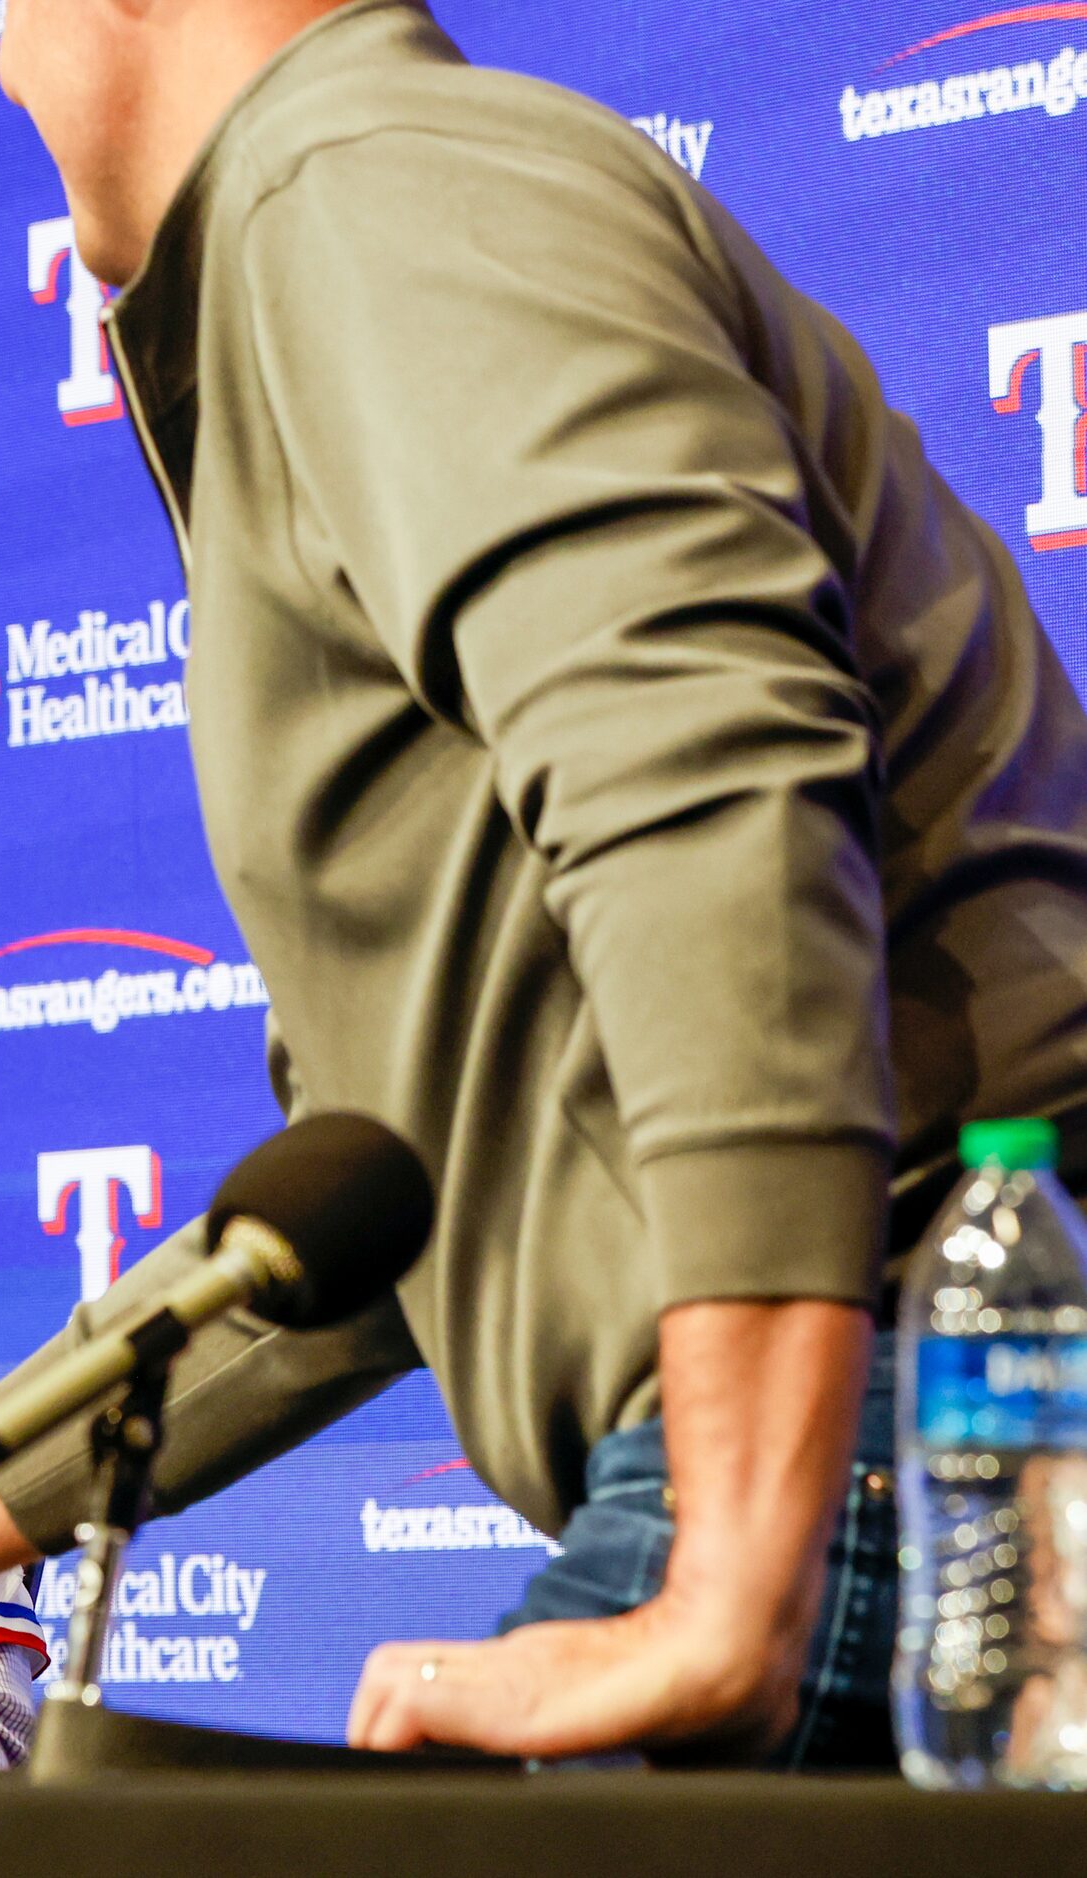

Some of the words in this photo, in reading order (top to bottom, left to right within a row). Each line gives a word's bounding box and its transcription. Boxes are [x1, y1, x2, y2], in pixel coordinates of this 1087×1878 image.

[6, 600, 167, 684] Medical
[7, 671, 190, 747] Healthca
[37, 1145, 162, 1324] T
[359, 1498, 567, 1558] texasra
[178, 1553, 267, 1630] City
